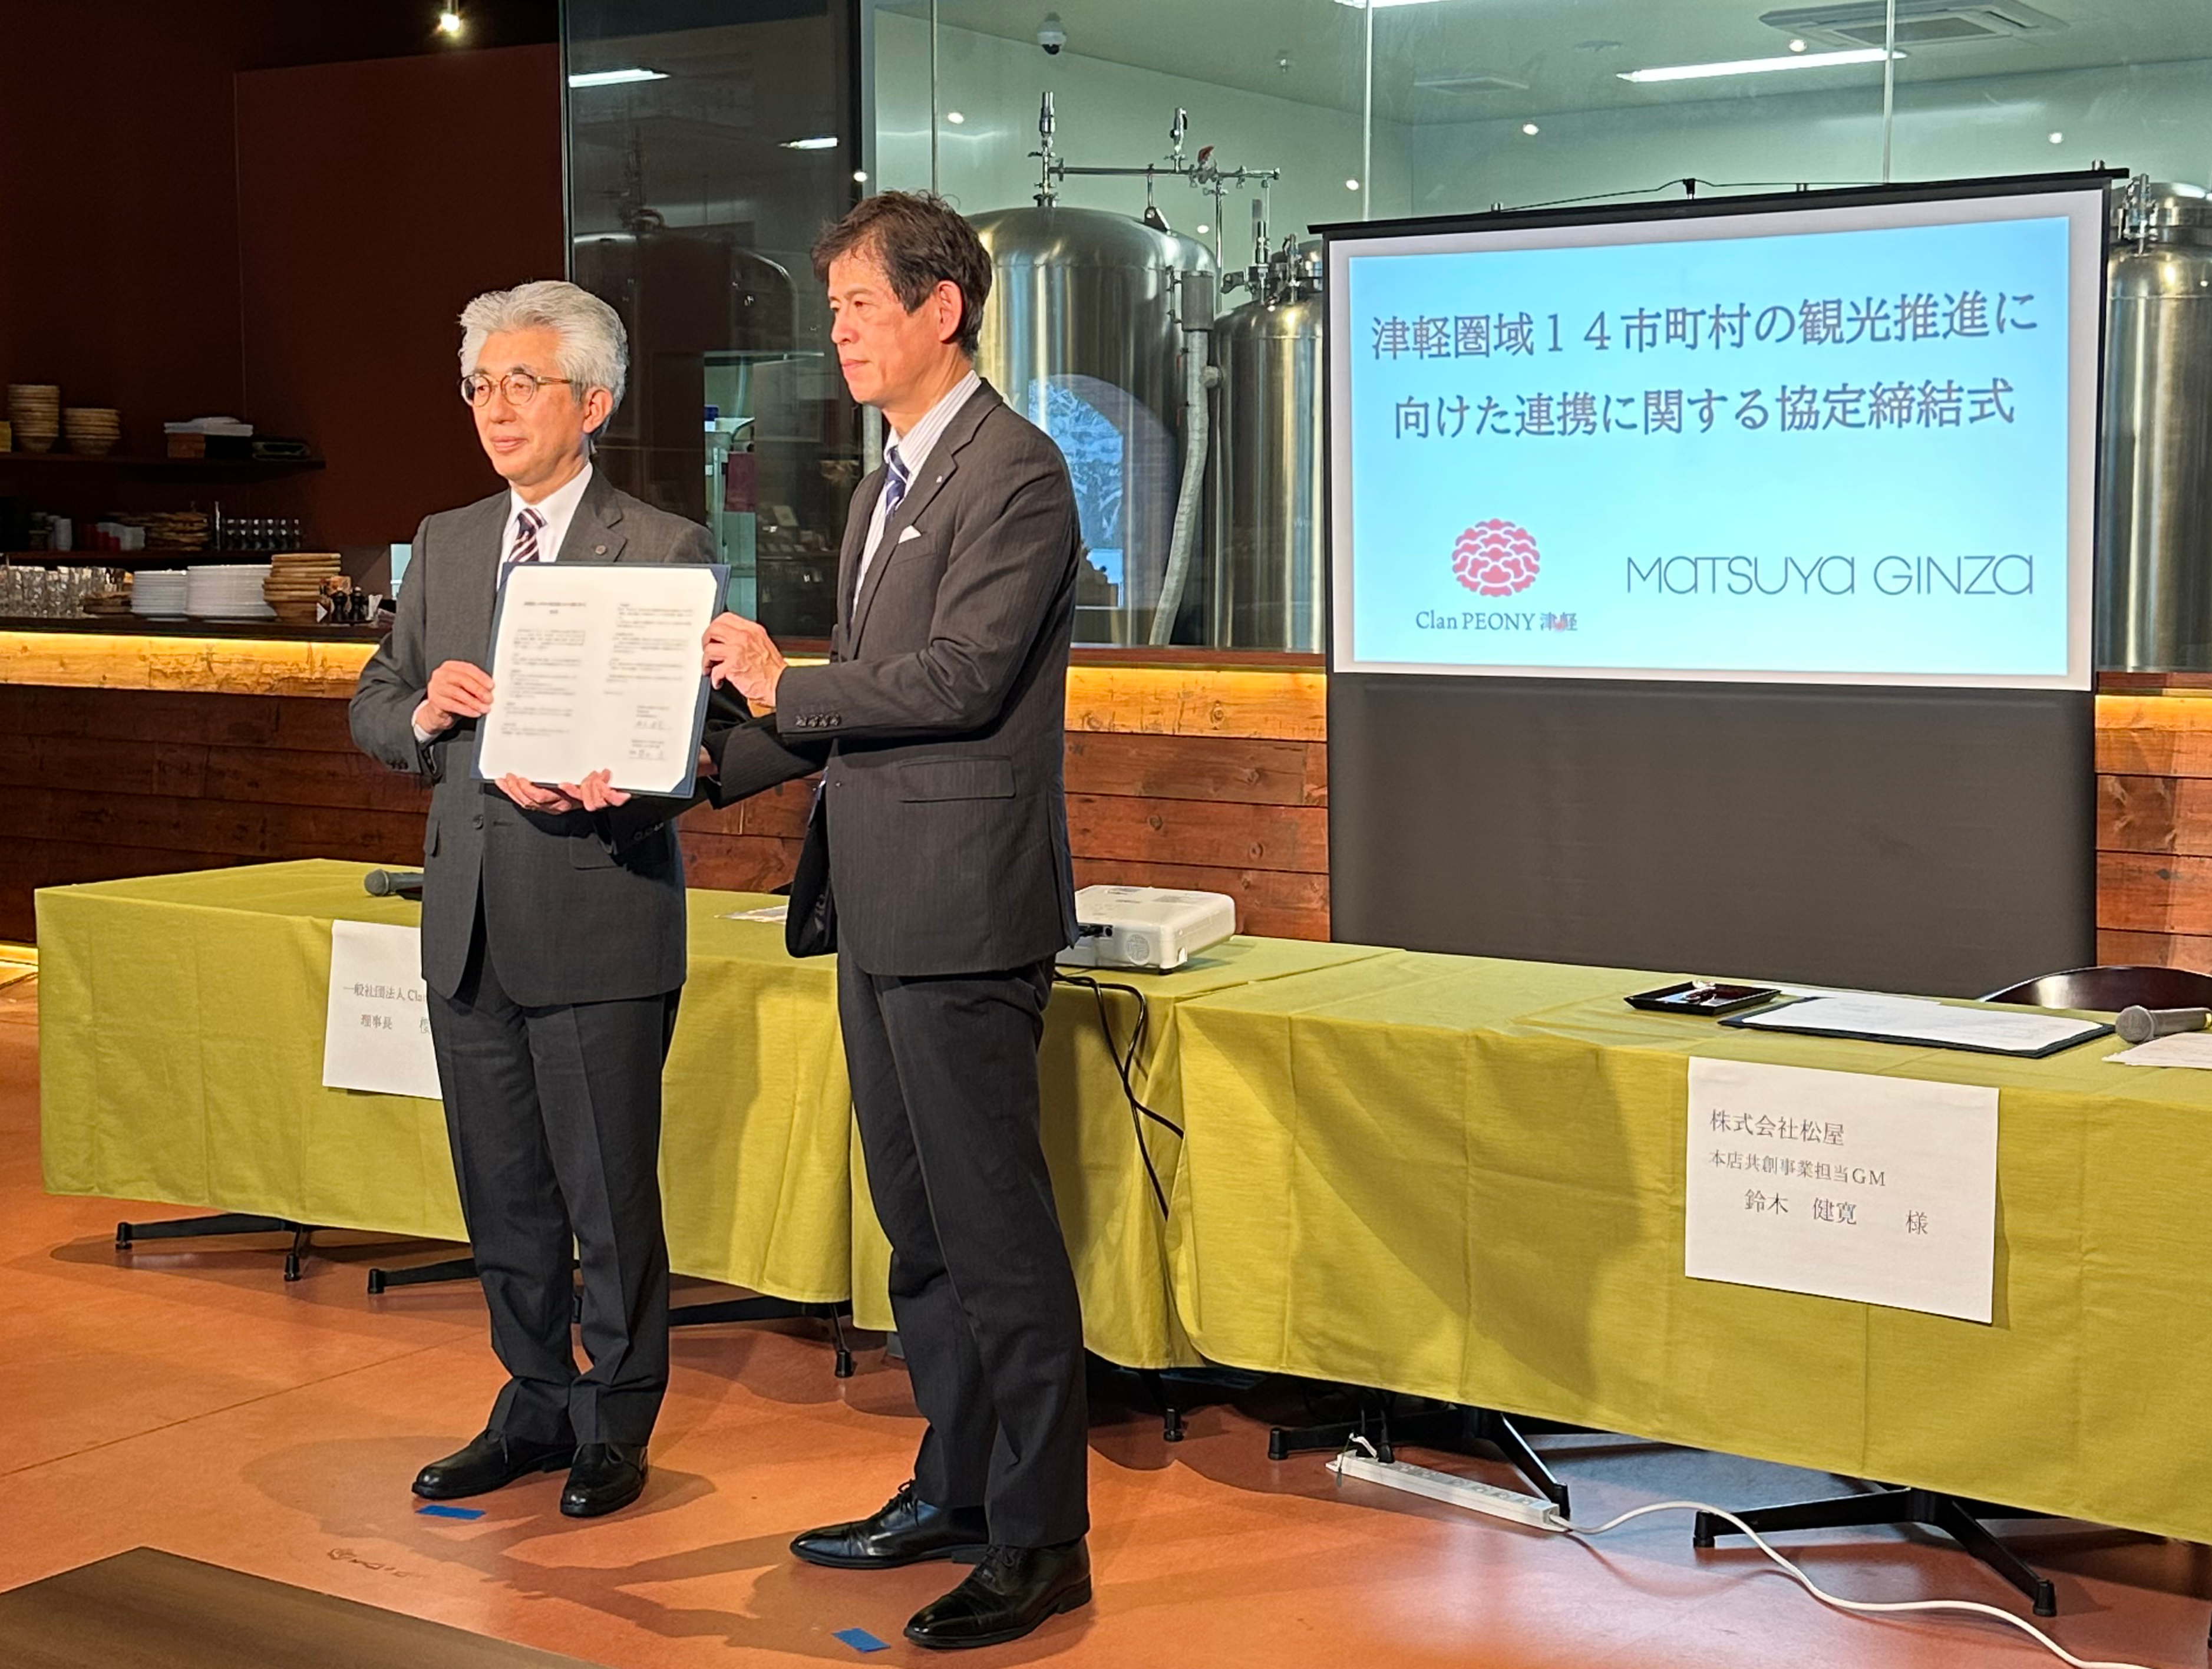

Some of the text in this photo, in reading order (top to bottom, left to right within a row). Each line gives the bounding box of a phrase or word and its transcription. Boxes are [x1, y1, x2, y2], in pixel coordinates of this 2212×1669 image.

[1396, 378, 2015, 440] 向けた連携に関する協定締結式
[1415, 610, 1579, 631] Clan PEONY 津軽
[1709, 1109, 1844, 1146] 株式会社松屋
[1744, 1188, 1788, 1215] 鈴木
[1904, 1209, 1929, 1235] 様
